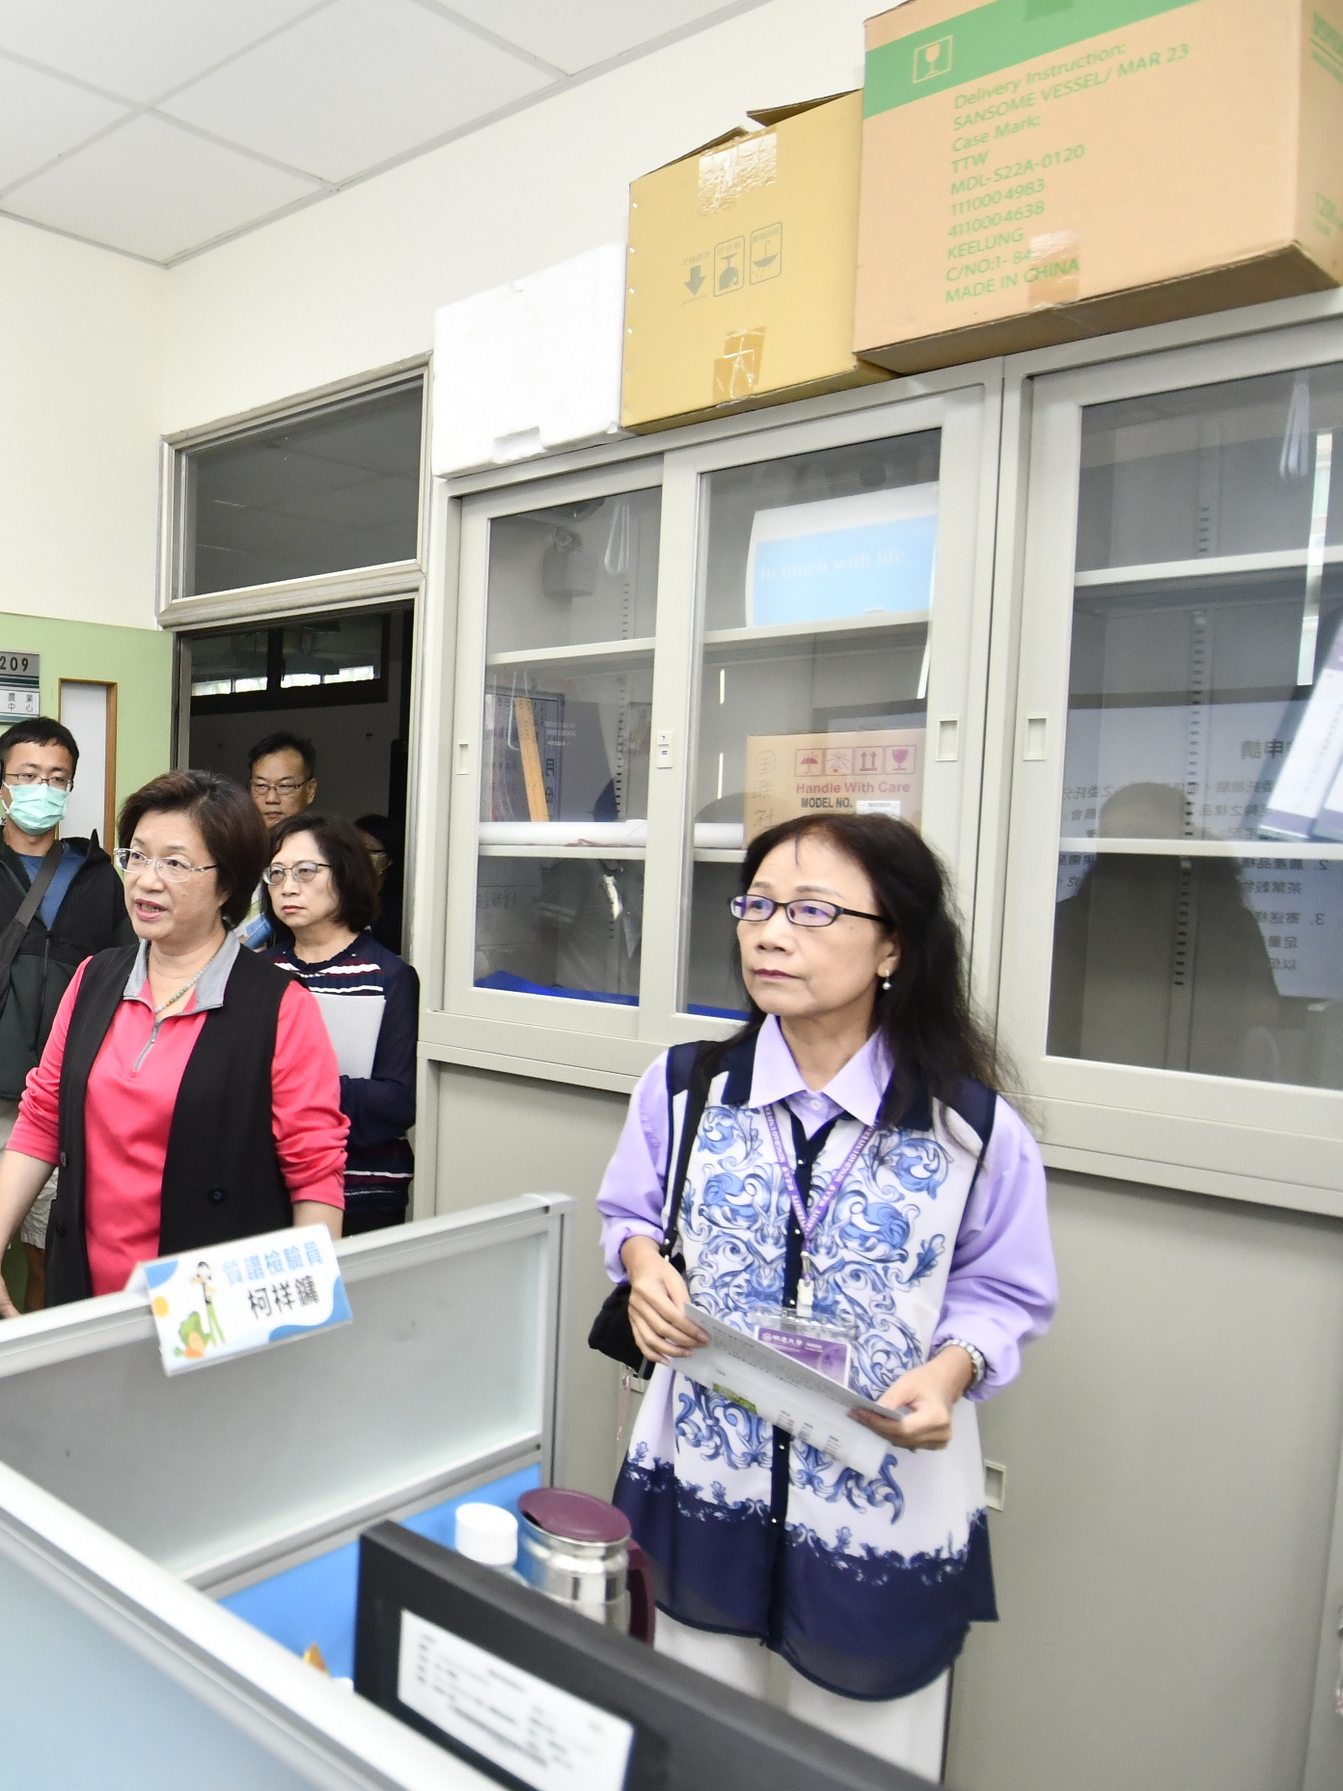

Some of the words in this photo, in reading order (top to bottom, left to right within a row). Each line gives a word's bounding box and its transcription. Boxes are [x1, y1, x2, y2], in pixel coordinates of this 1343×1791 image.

[953, 93, 1035, 131] SANSOME
[1041, 67, 1112, 101] VESSEL/
[1117, 52, 1161, 79] MAR
[1166, 43, 1189, 63] 23
[954, 78, 1021, 110] Delivery
[1026, 43, 1126, 85] Instruction:
[952, 132, 989, 152] Case
[994, 115, 1041, 139] Mark:
[951, 151, 988, 173] TTW
[951, 144, 1086, 195] MDL-S22A-0120
[948, 227, 1024, 260] KEELUNG
[946, 279, 995, 303] MADE
[1001, 272, 1018, 288] IN
[1023, 258, 1080, 283] CHINA
[782, 559, 827, 578] touch
[834, 553, 871, 569] with
[877, 548, 905, 565] life
[0, 655, 29, 672] 209
[796, 781, 842, 796] Handle
[844, 780, 875, 794] With
[877, 779, 911, 794] Care
[801, 798, 833, 809] MODEL
[836, 797, 853, 808] NO.
[222, 1241, 325, 1288] 質譜檢驗員
